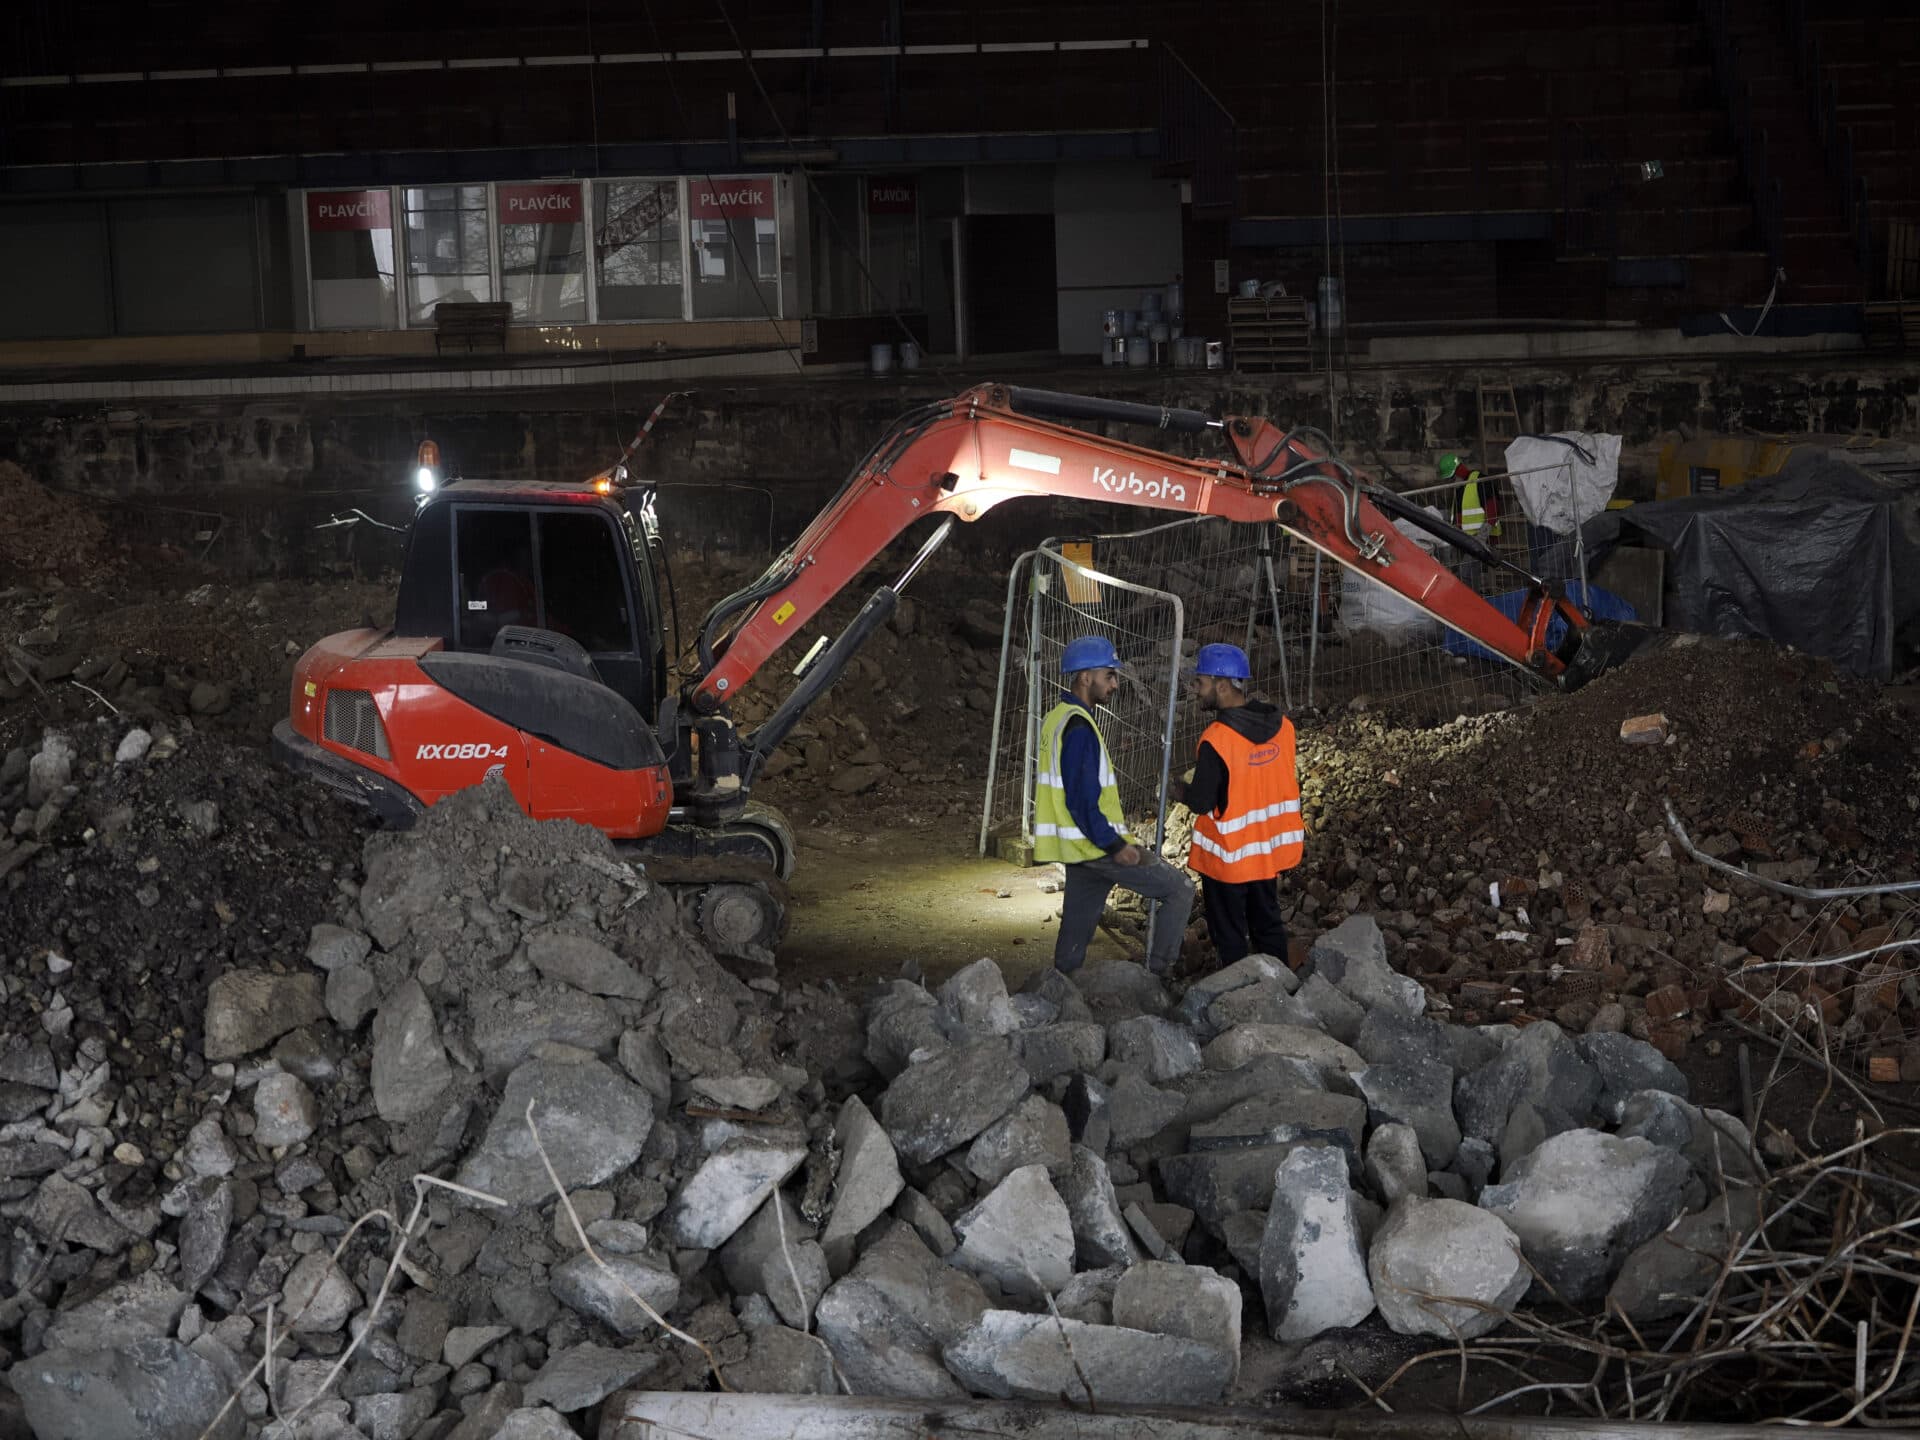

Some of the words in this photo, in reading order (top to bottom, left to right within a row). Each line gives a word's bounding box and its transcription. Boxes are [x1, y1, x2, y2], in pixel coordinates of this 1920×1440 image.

[510, 193, 572, 211] PLAVČÍK
[700, 189, 763, 207] PLAVČÍK
[1092, 466, 1186, 502] Kubota
[415, 743, 508, 760] KX080-4
